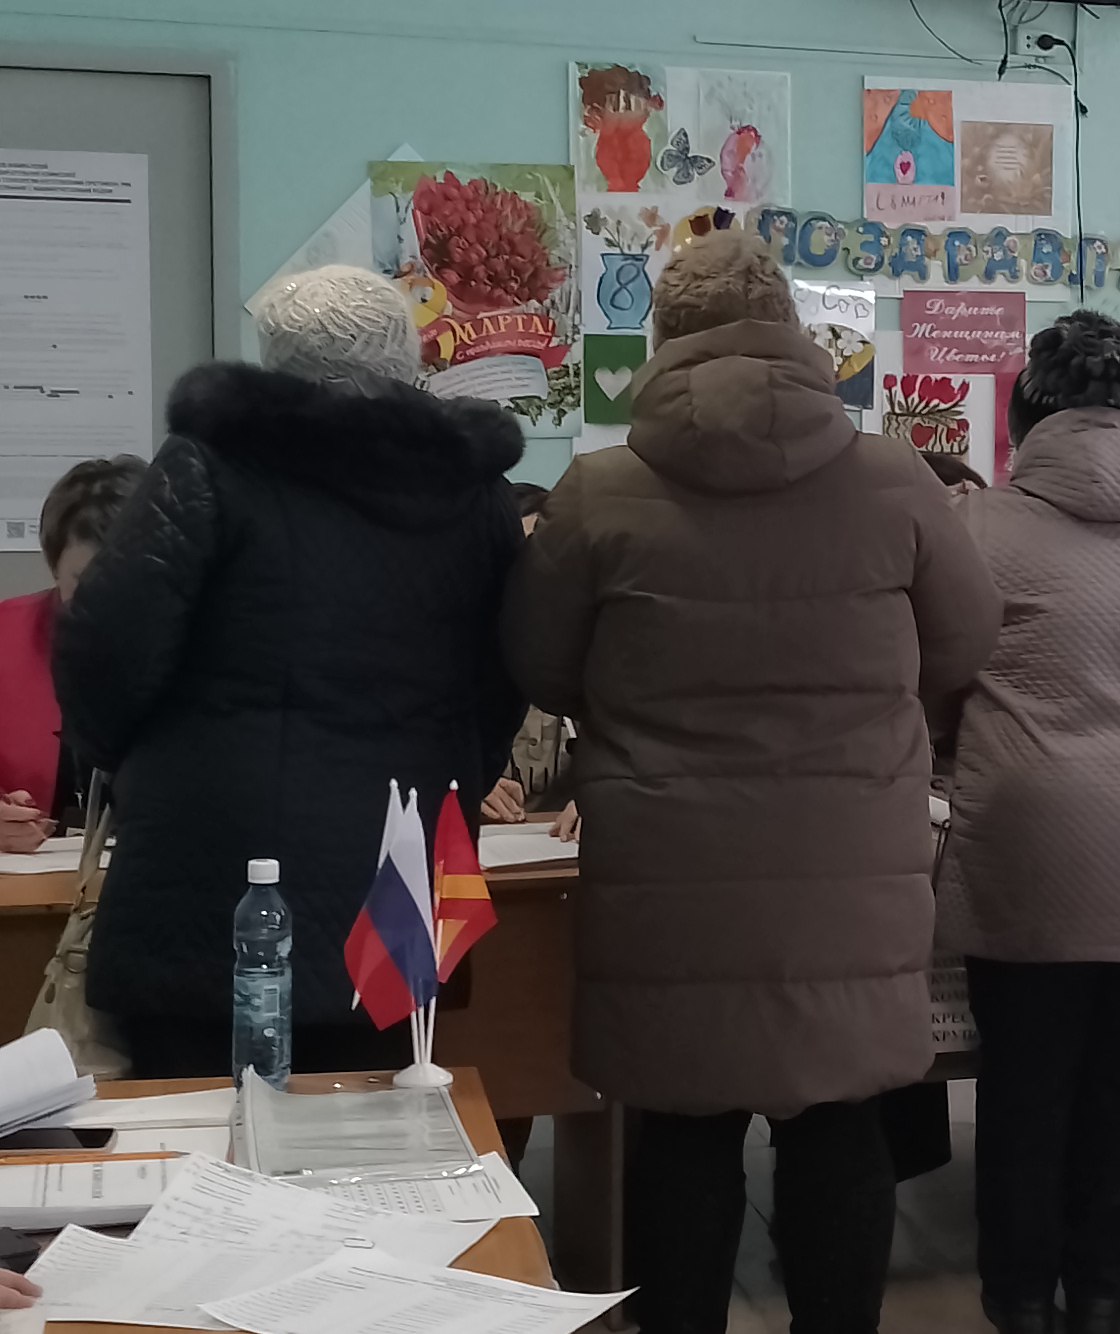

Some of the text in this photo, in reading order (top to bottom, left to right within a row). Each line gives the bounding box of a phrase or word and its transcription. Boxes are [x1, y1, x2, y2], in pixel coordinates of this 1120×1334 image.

[609, 261, 640, 311] 8
[925, 298, 1005, 321] Дарите
[441, 315, 553, 346] МАРТА!
[905, 322, 1022, 341] Женщинам
[929, 346, 1006, 364] Цветы!
[931, 1012, 969, 1024] КРЕС
